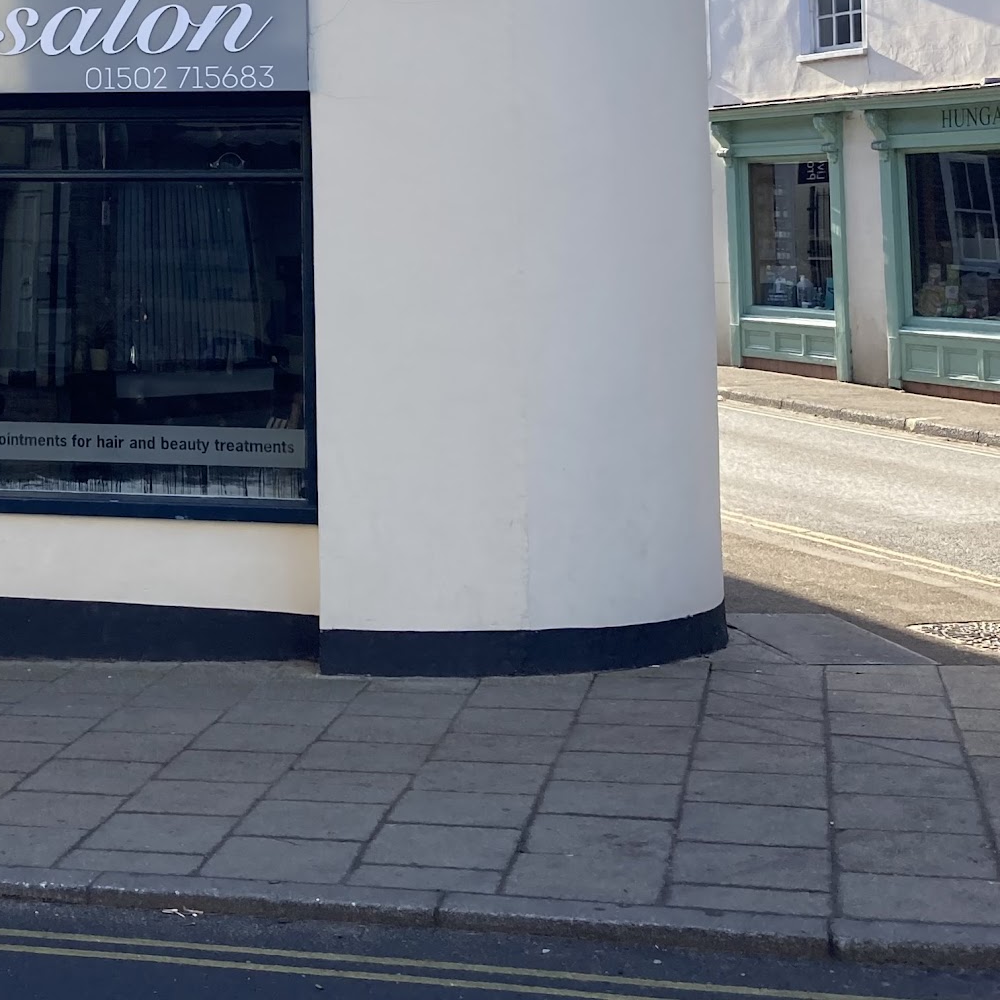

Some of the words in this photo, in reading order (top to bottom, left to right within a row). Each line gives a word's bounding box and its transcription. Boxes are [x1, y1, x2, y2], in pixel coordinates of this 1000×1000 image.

[85, 66, 167, 90] 01502
[177, 65, 275, 89] 715683
[71, 434, 92, 448] for
[97, 435, 124, 449] hair
[129, 436, 155, 450] and
[161, 437, 210, 454] beauty
[215, 439, 295, 454] treatments
